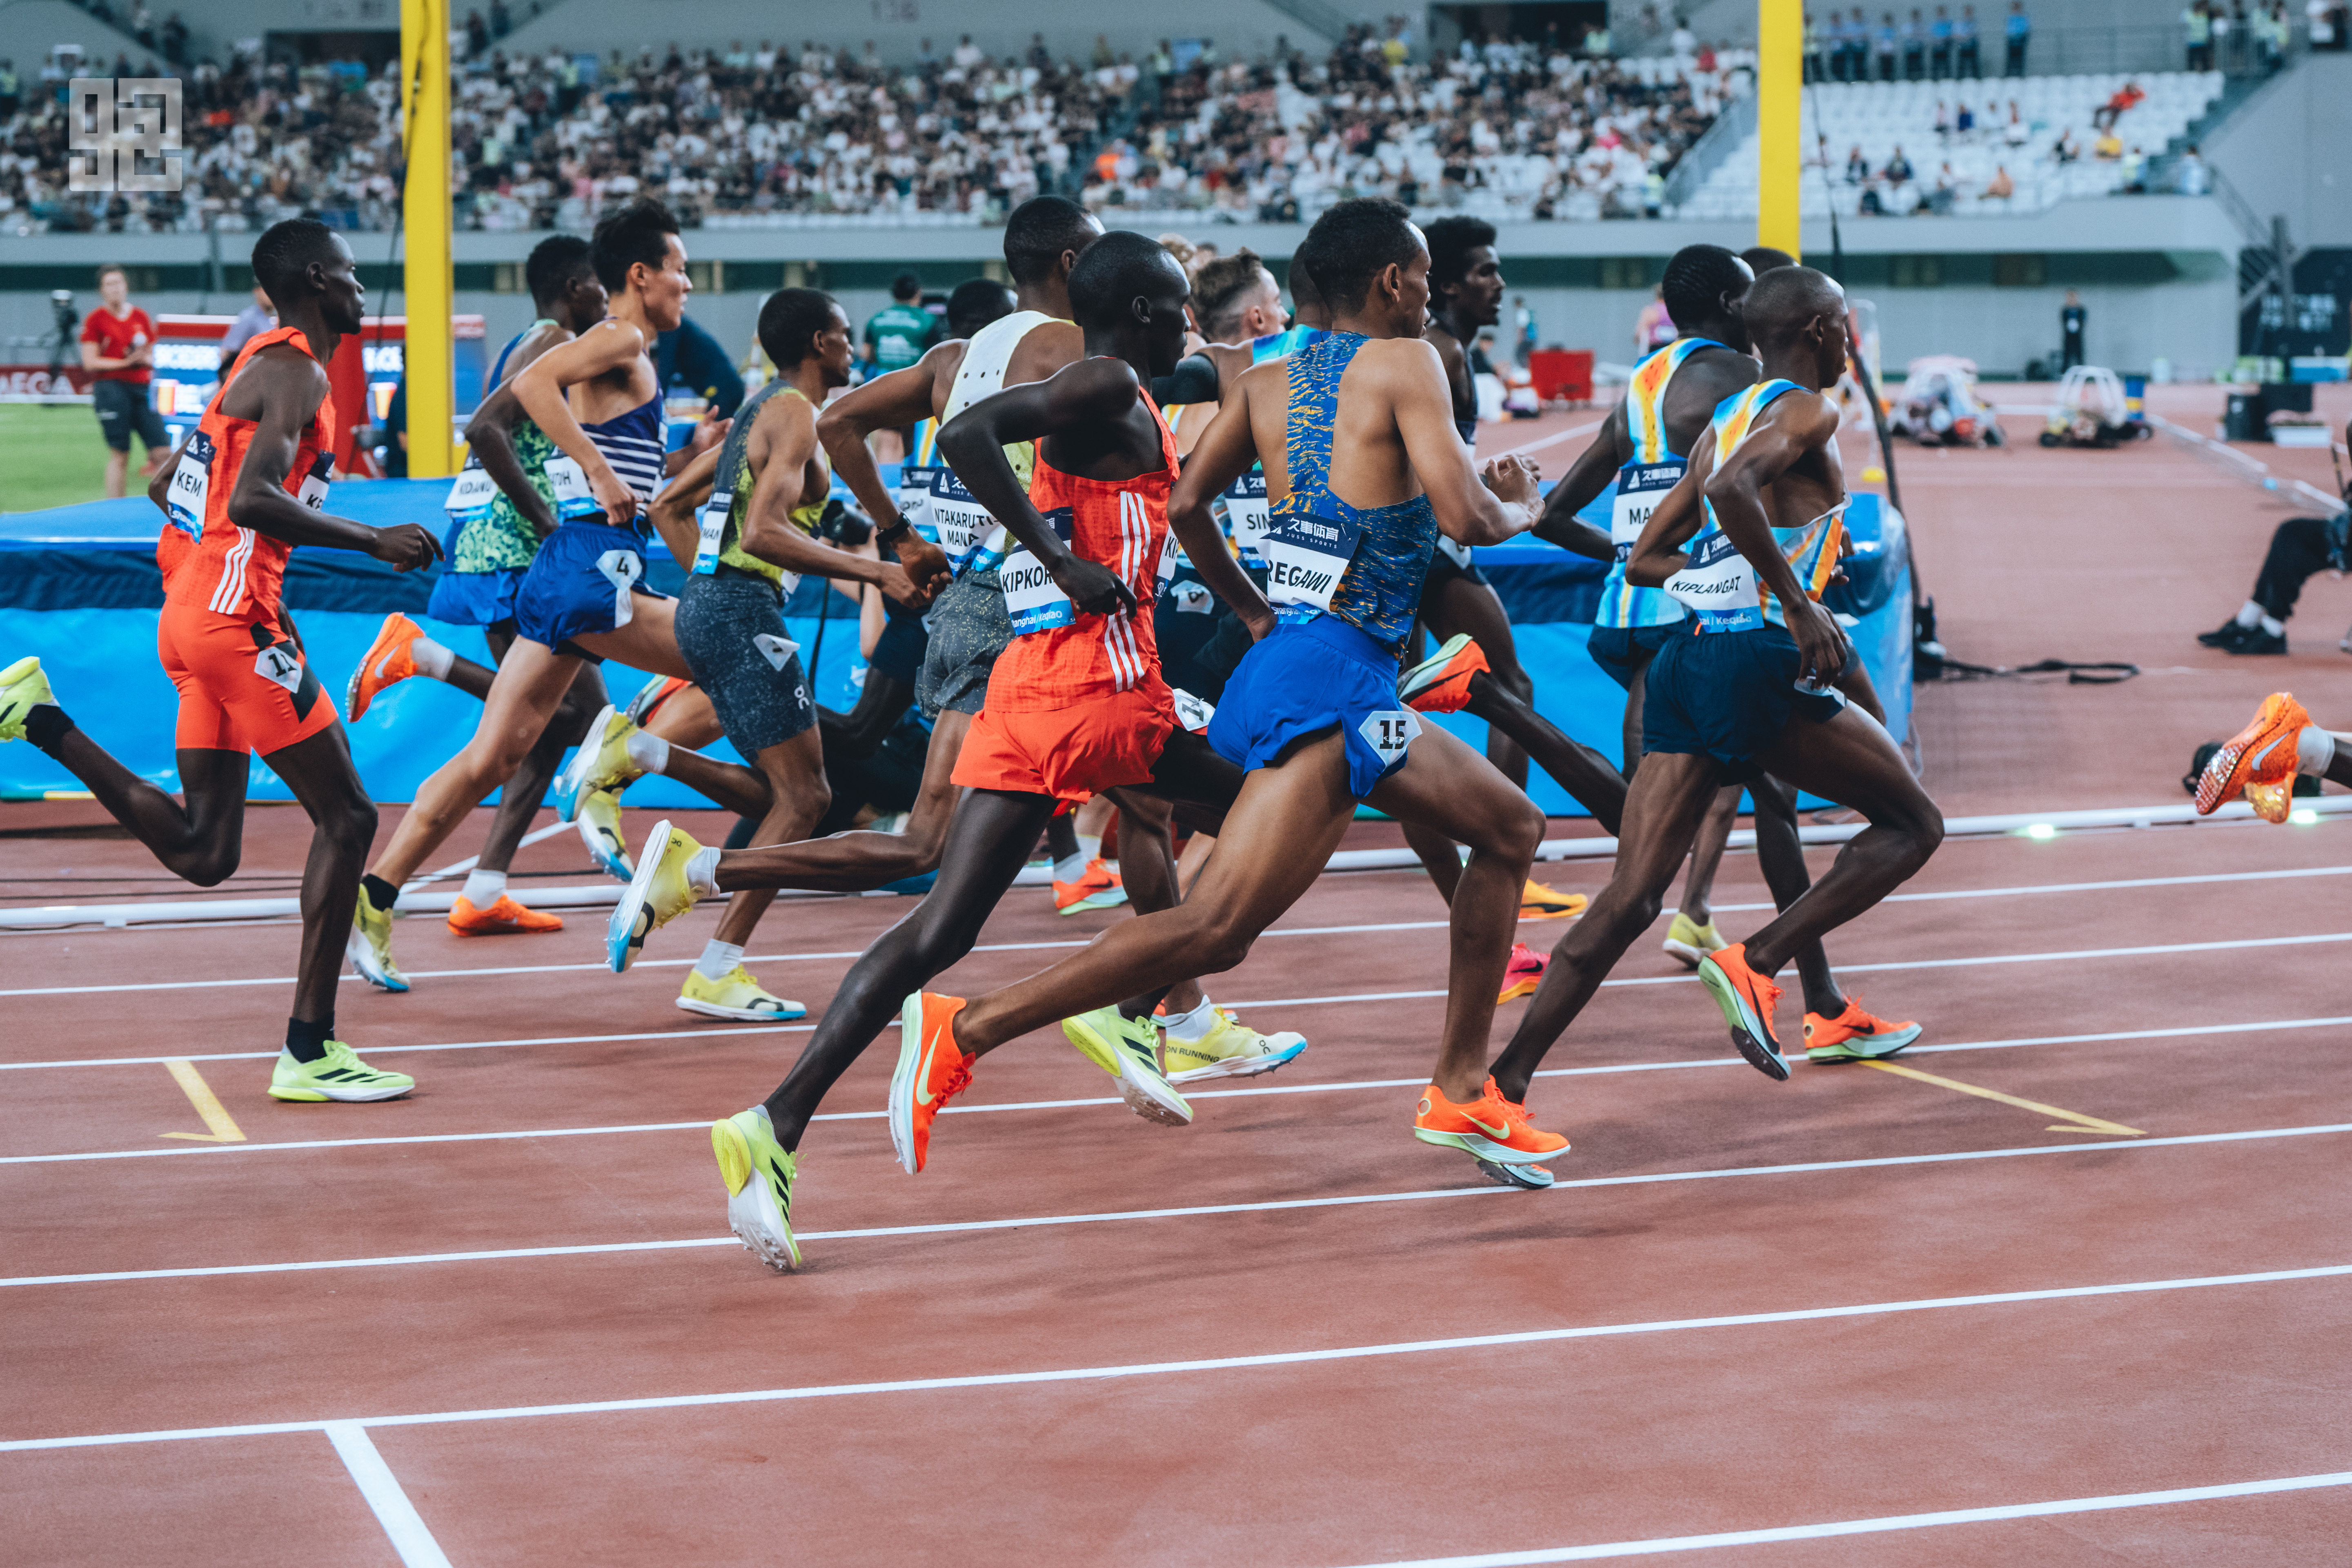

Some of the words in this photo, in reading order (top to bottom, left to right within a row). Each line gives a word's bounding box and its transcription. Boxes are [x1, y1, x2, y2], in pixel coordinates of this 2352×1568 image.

[1629, 506, 1658, 524] MA
[947, 529, 979, 547] MANA
[1287, 517, 1339, 542] 久事体育
[1310, 538, 1337, 549] SPORTS
[616, 557, 629, 576] 4
[1671, 576, 1741, 594] KIPLANGAT
[1379, 720, 1407, 750] 15
[1179, 1048, 1220, 1063] RUNNING
